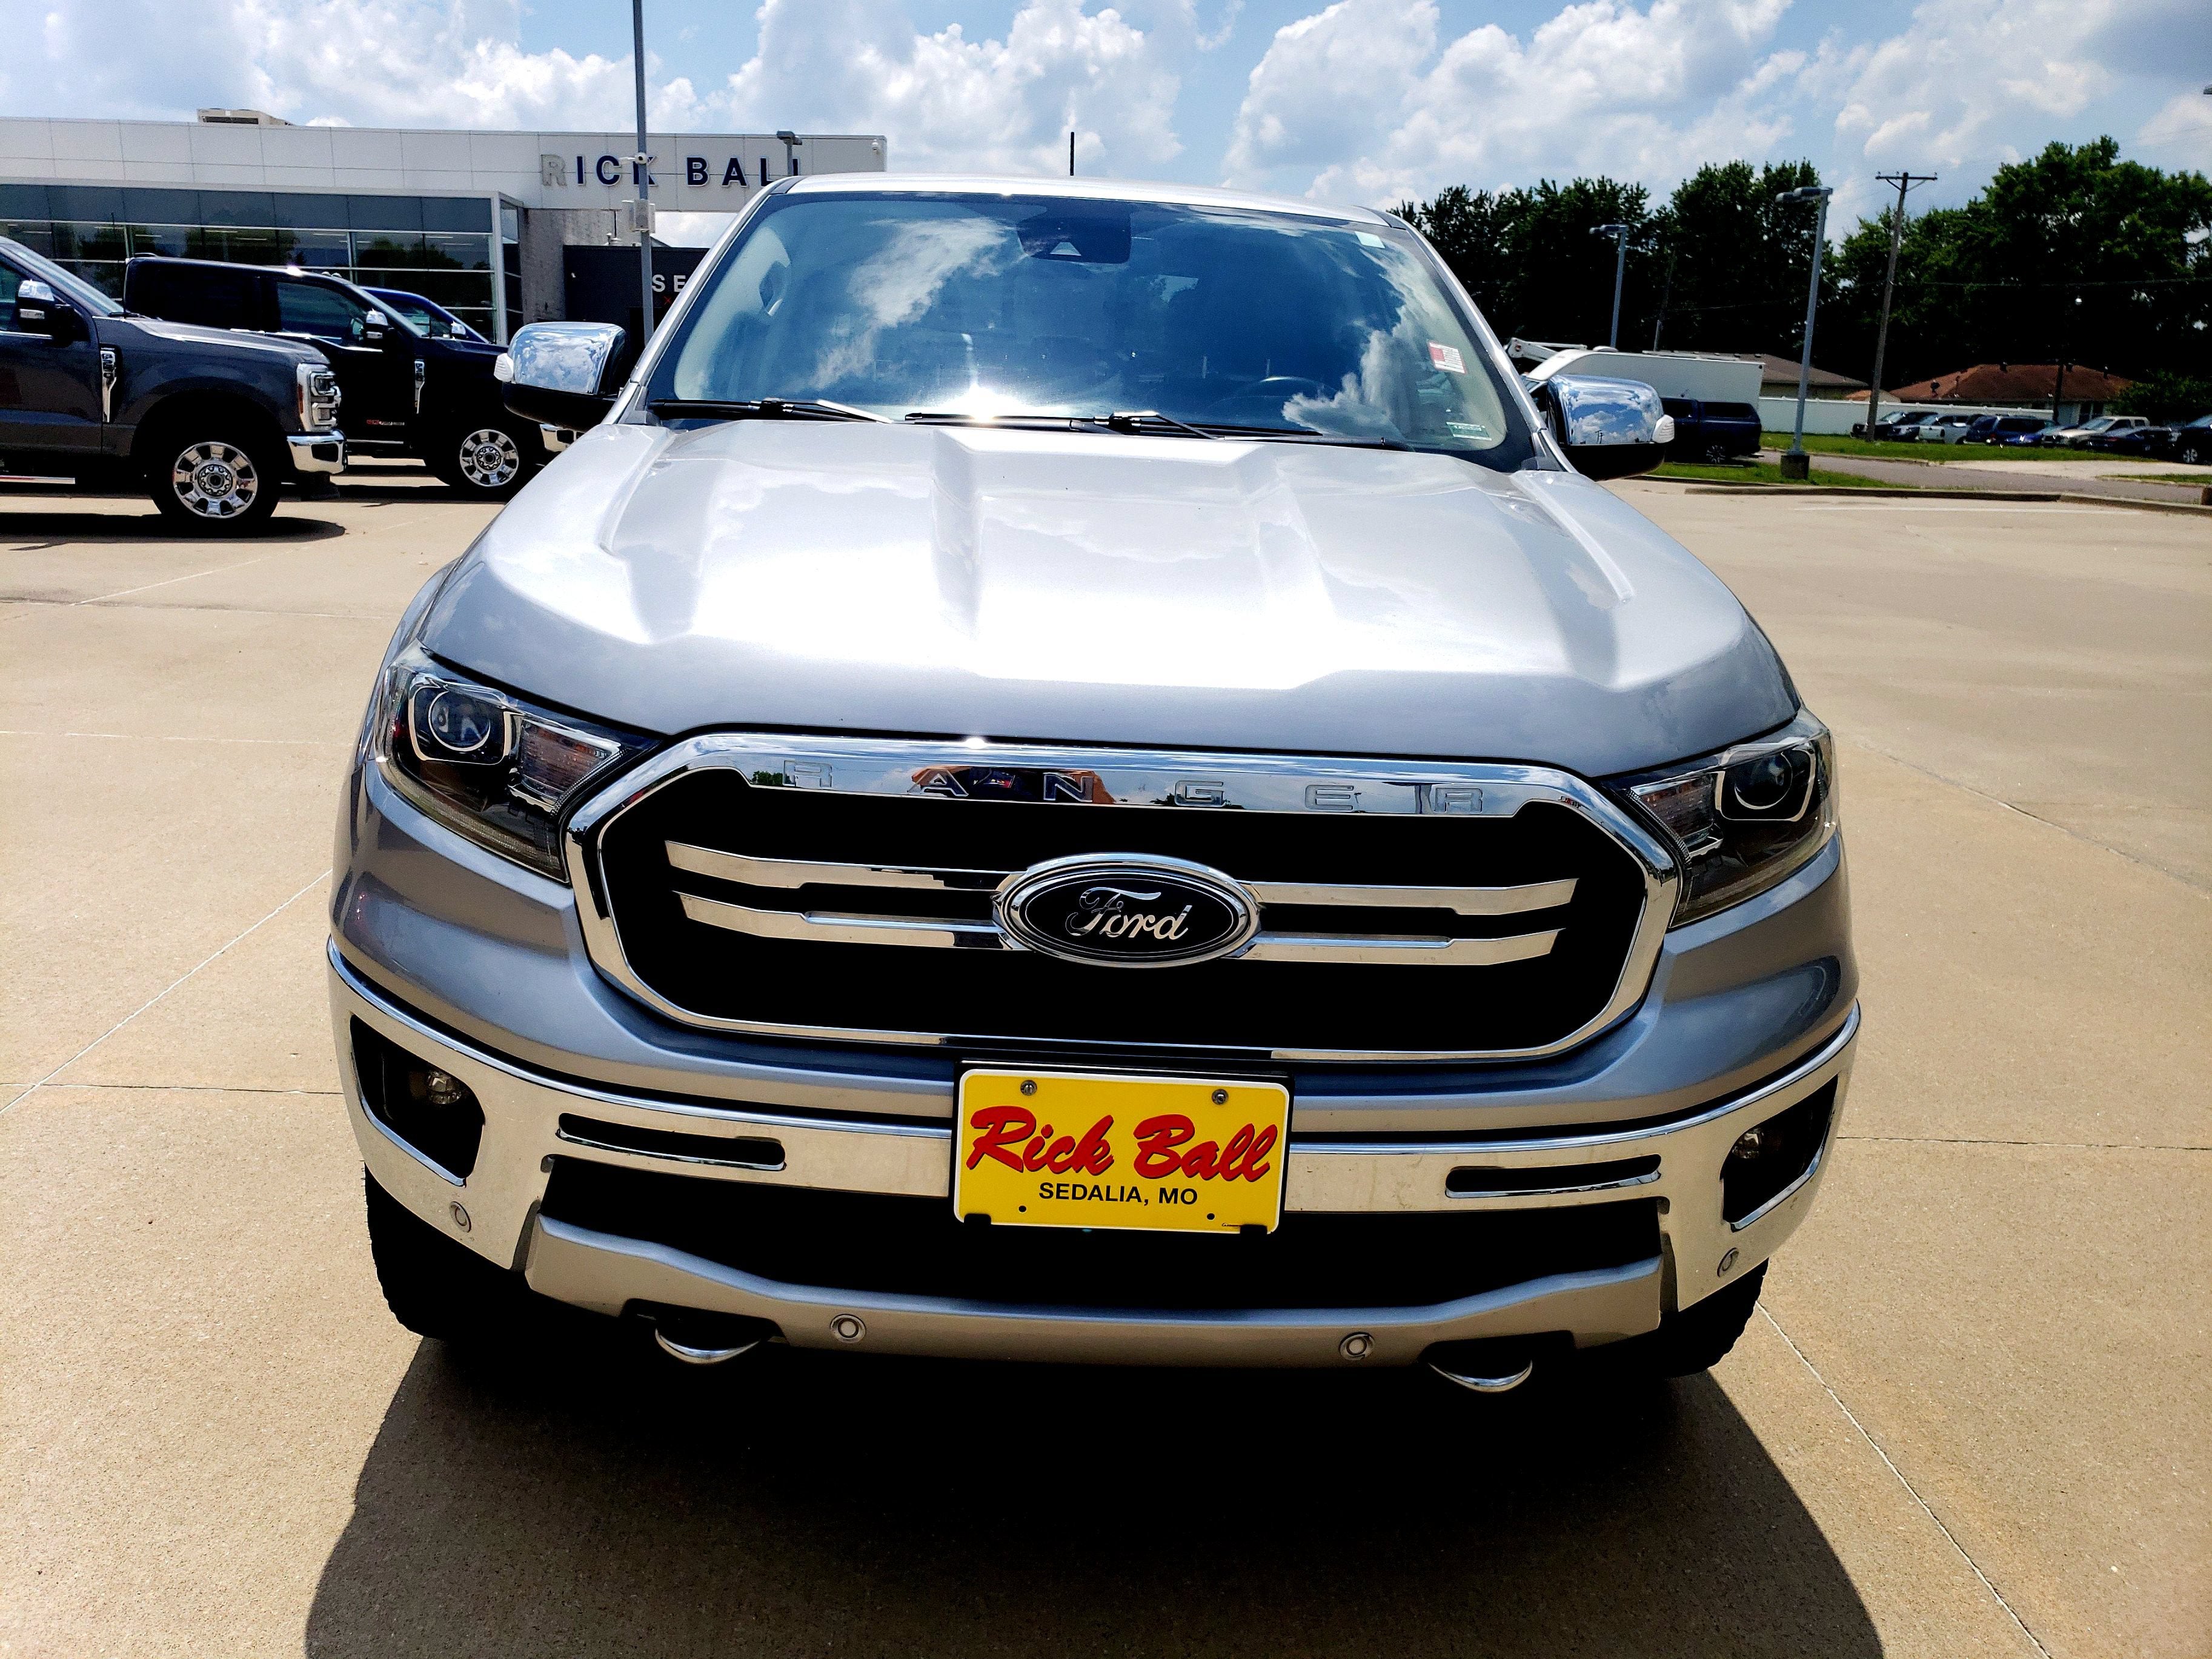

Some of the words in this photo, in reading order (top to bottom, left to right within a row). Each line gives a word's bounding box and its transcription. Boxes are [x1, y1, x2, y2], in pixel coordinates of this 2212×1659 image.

[541, 154, 658, 186] RICK
[783, 759, 1483, 813] RANGER
[1065, 886, 1194, 940] Ford
[966, 1105, 1115, 1177] Rick
[1132, 1114, 1278, 1183] Ball
[1038, 1182, 1150, 1206] SEDALIA,
[1158, 1187, 1198, 1205] MO
